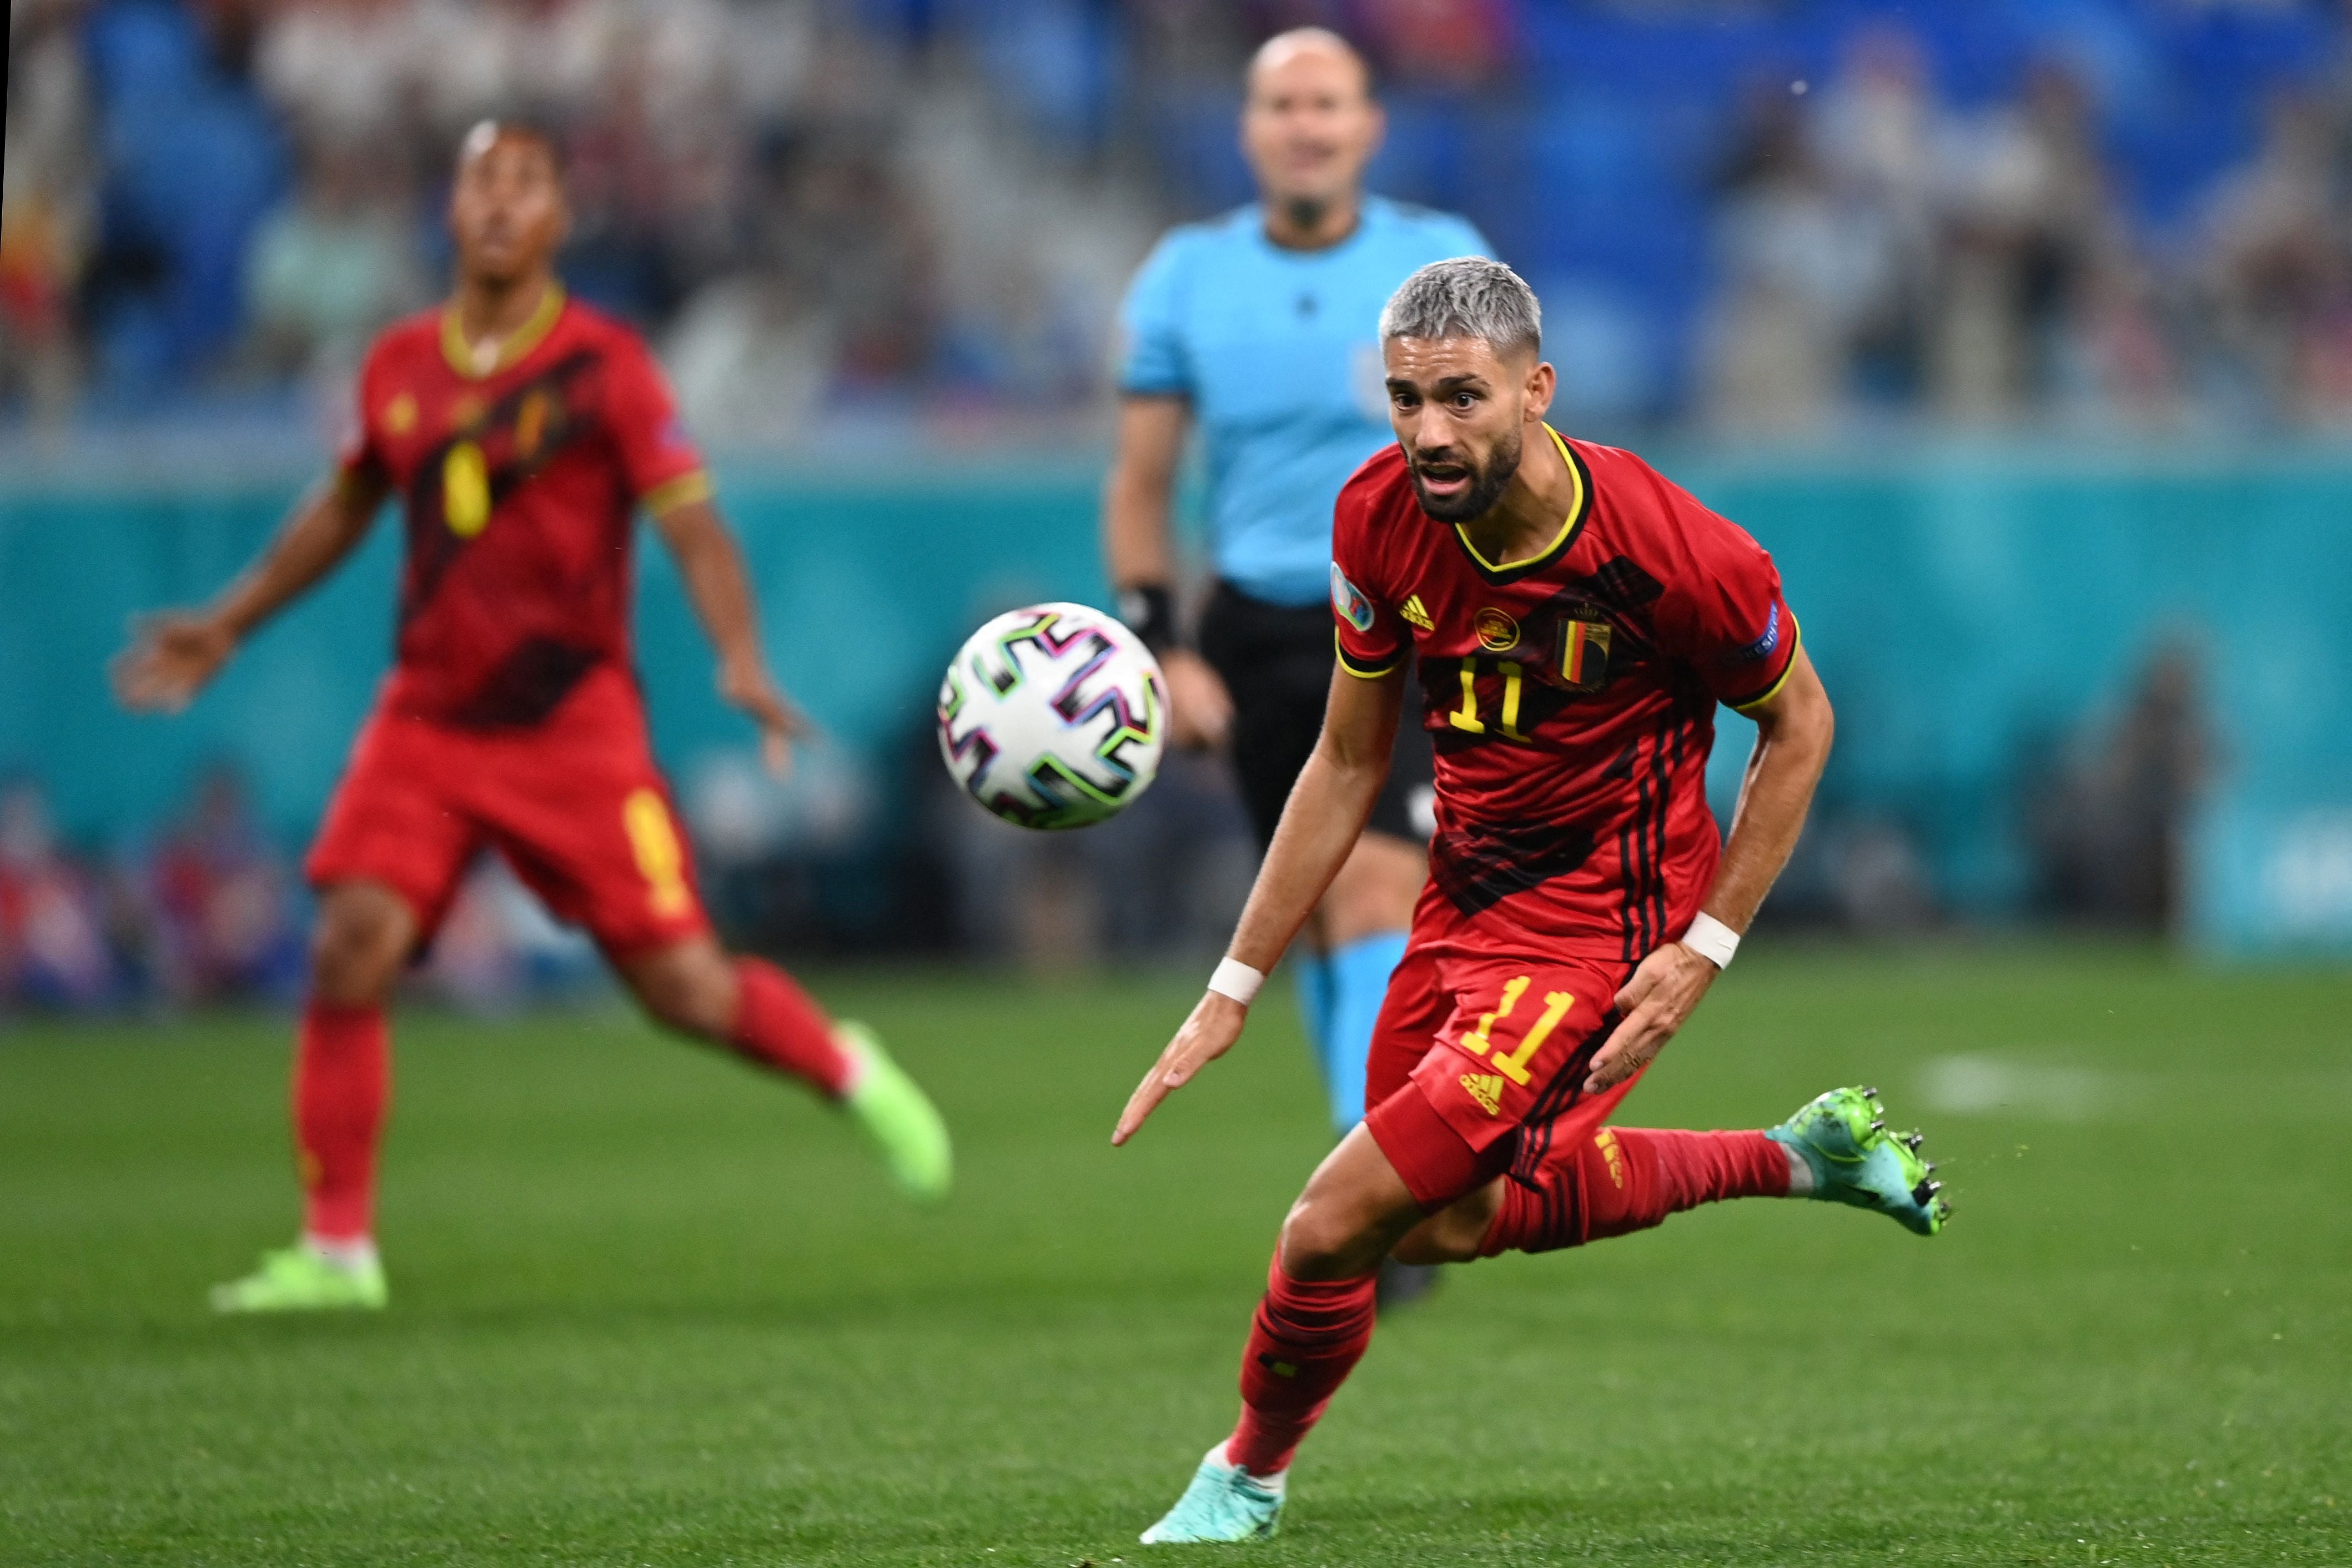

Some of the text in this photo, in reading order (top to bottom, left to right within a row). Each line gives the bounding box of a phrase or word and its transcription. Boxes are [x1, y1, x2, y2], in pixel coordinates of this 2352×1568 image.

[1399, 609, 1435, 631] adidas
[1745, 605, 1778, 657] RESPE
[1449, 656, 1534, 744] 11
[1460, 976, 1575, 1086] 11
[1459, 1073, 1500, 1116] adidas
